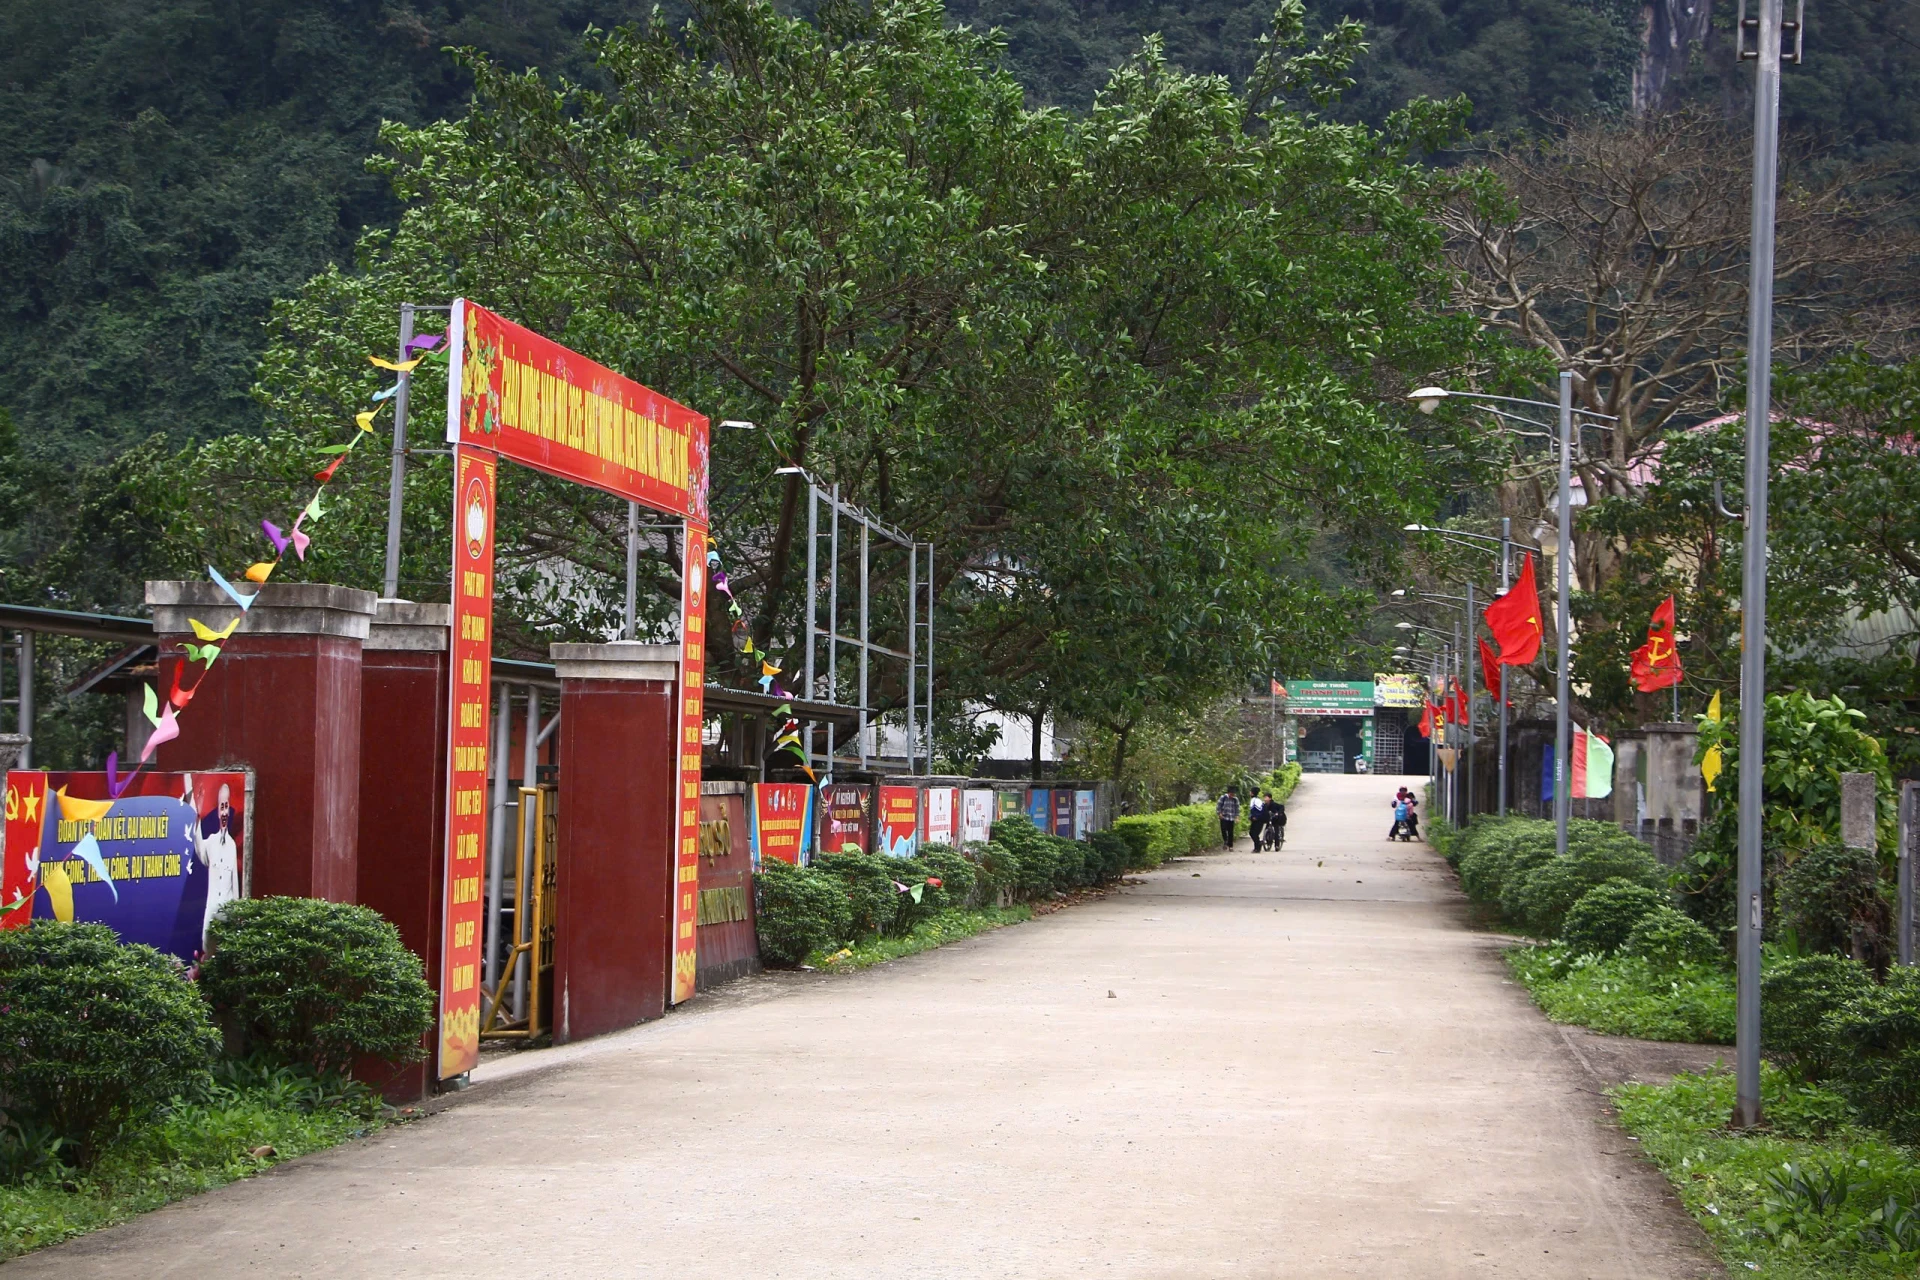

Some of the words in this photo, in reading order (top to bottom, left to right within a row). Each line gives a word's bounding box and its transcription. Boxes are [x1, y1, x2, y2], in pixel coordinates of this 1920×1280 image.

[128, 816, 139, 844] ĐẠI
[140, 811, 156, 838] ĐOÀN
[157, 809, 169, 838] KẾT
[111, 852, 130, 881] CÔNG,
[132, 856, 142, 883] ĐẠI
[144, 851, 163, 877] THÀNH
[164, 850, 181, 876] CÔNG
